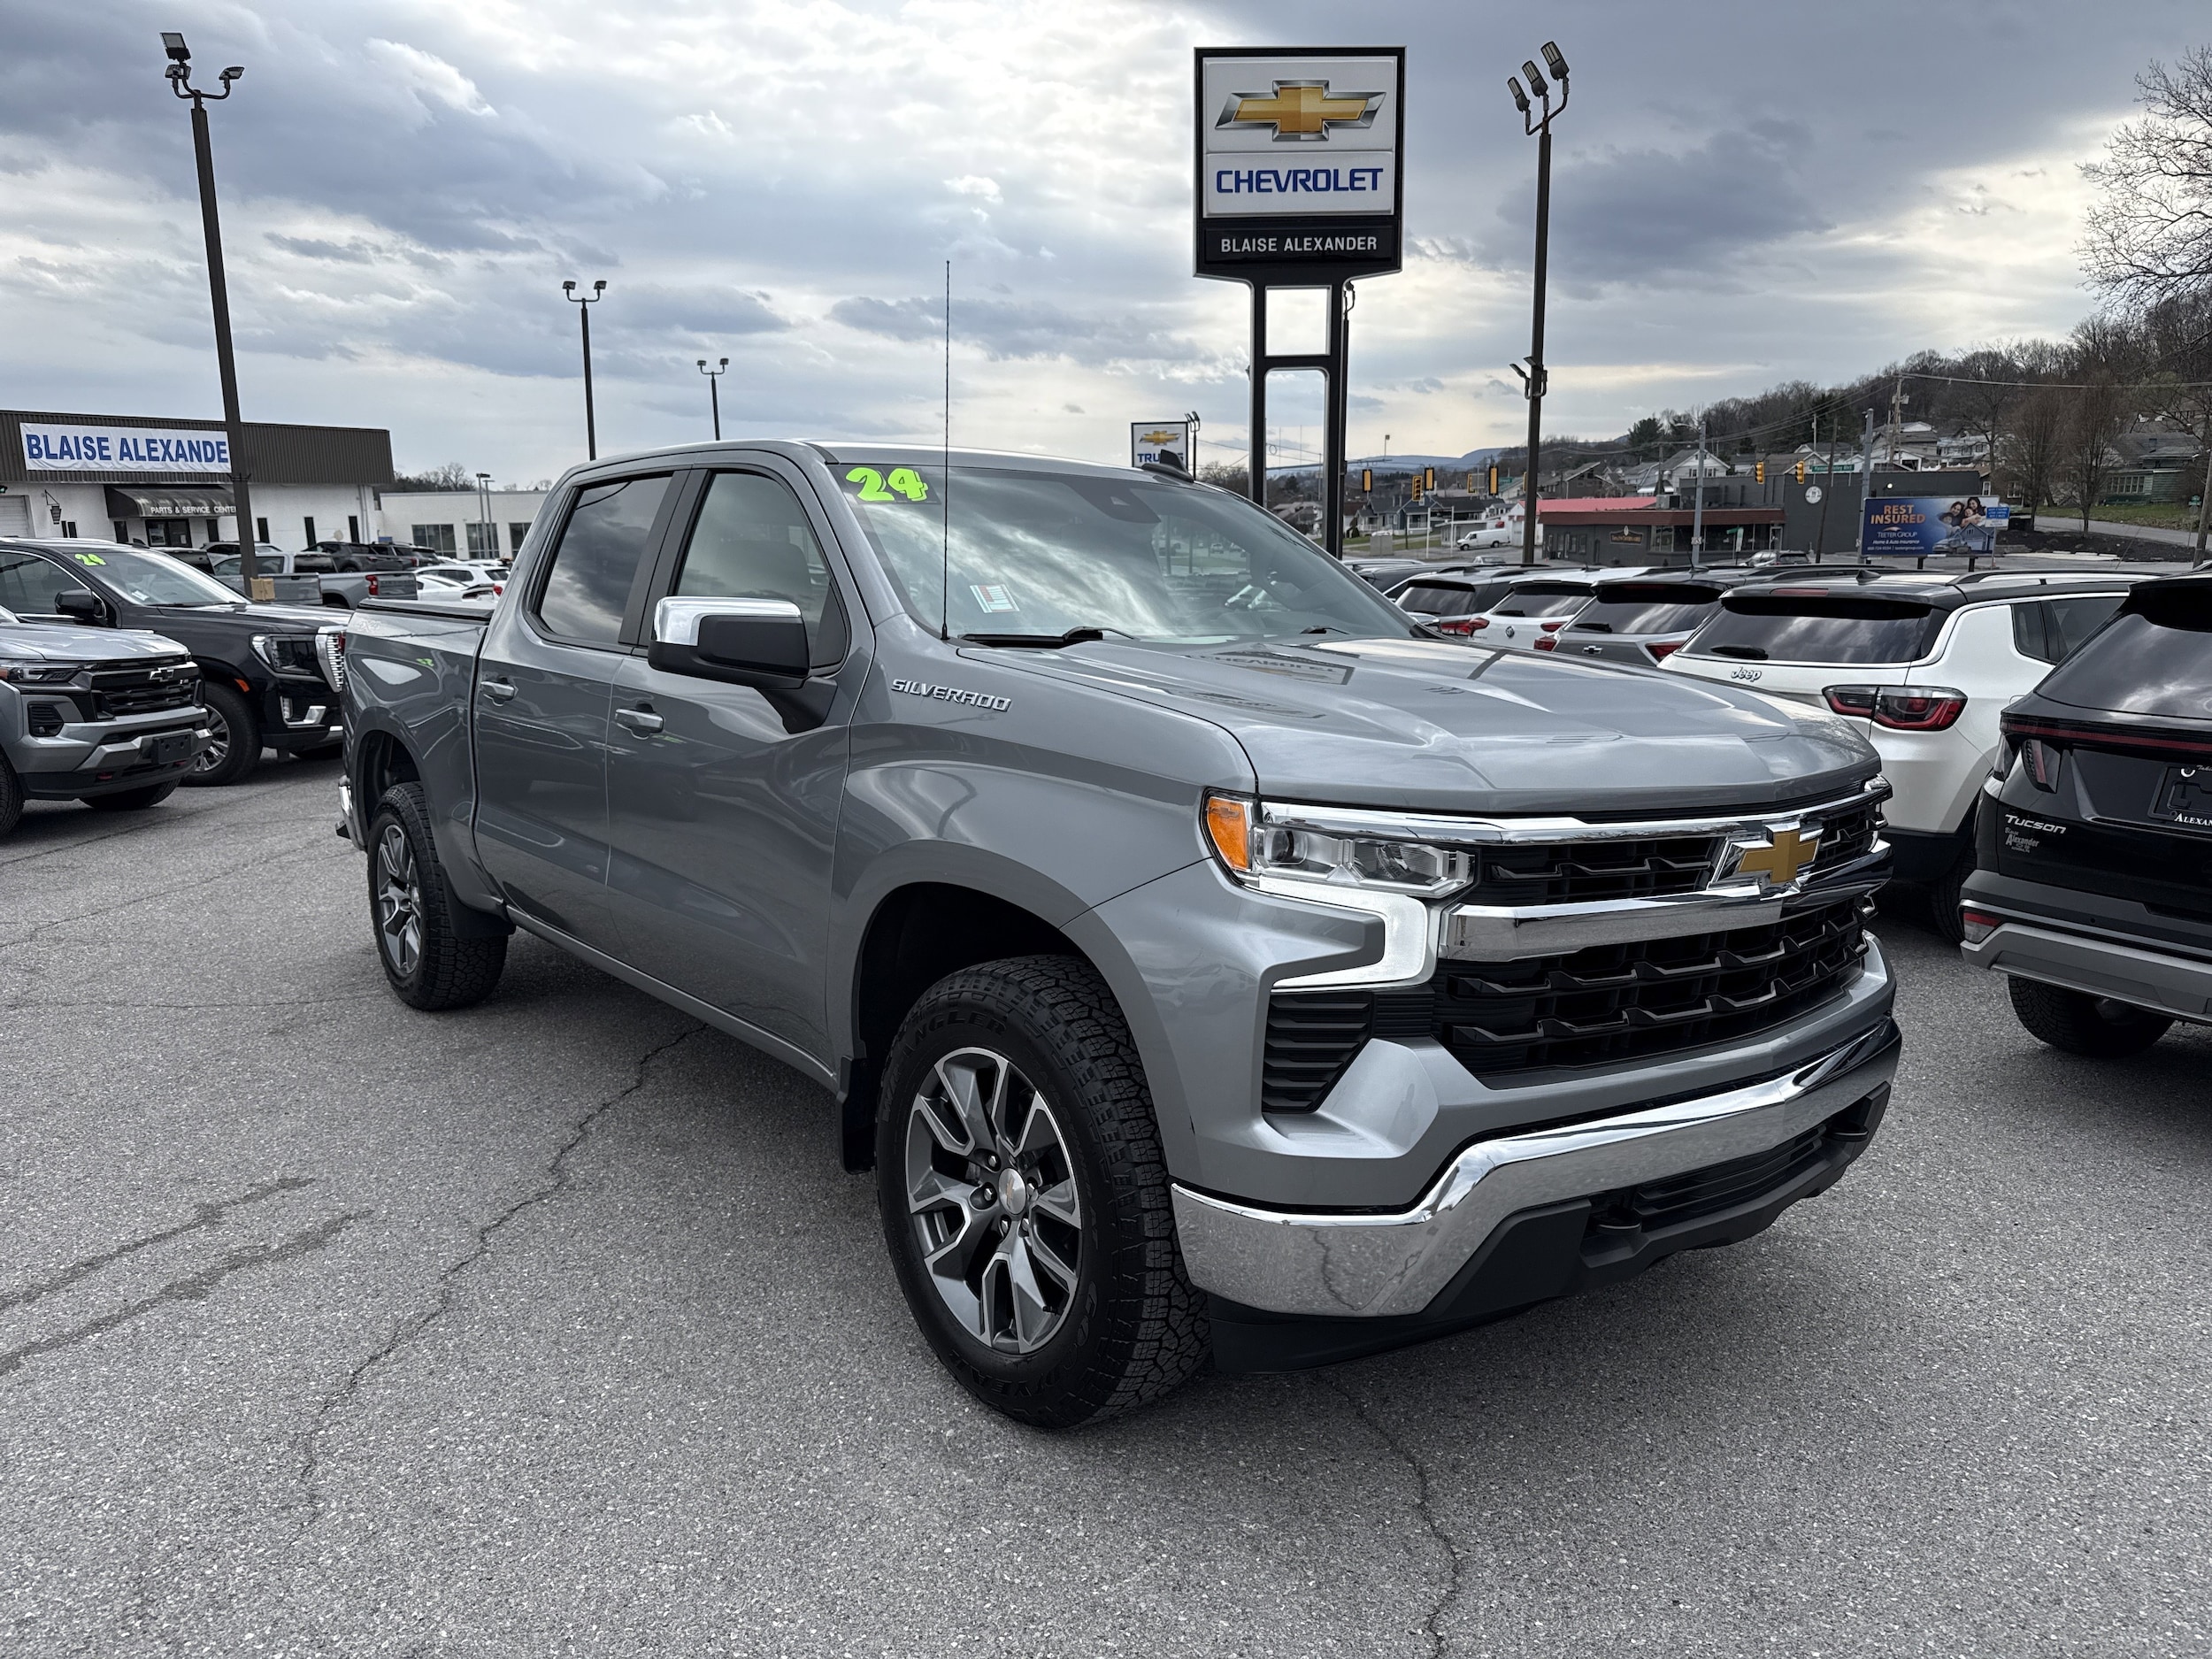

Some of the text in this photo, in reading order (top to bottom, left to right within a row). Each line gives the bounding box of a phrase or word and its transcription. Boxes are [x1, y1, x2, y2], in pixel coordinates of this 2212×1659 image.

[1216, 167, 1384, 193] CHEVROLET
[1220, 236, 1378, 253] BLAISE ALEXANDER
[26, 434, 229, 463] BLAISE ALEXANDE
[1137, 452, 1184, 463] TRU
[845, 466, 929, 502] 24
[1883, 504, 1915, 515] REST
[1870, 513, 1926, 525] INSURED
[74, 553, 107, 566] 24
[1731, 665, 1763, 682] Jeep
[891, 679, 1013, 712] SILVERADO
[2005, 833, 2040, 848] Alexander
